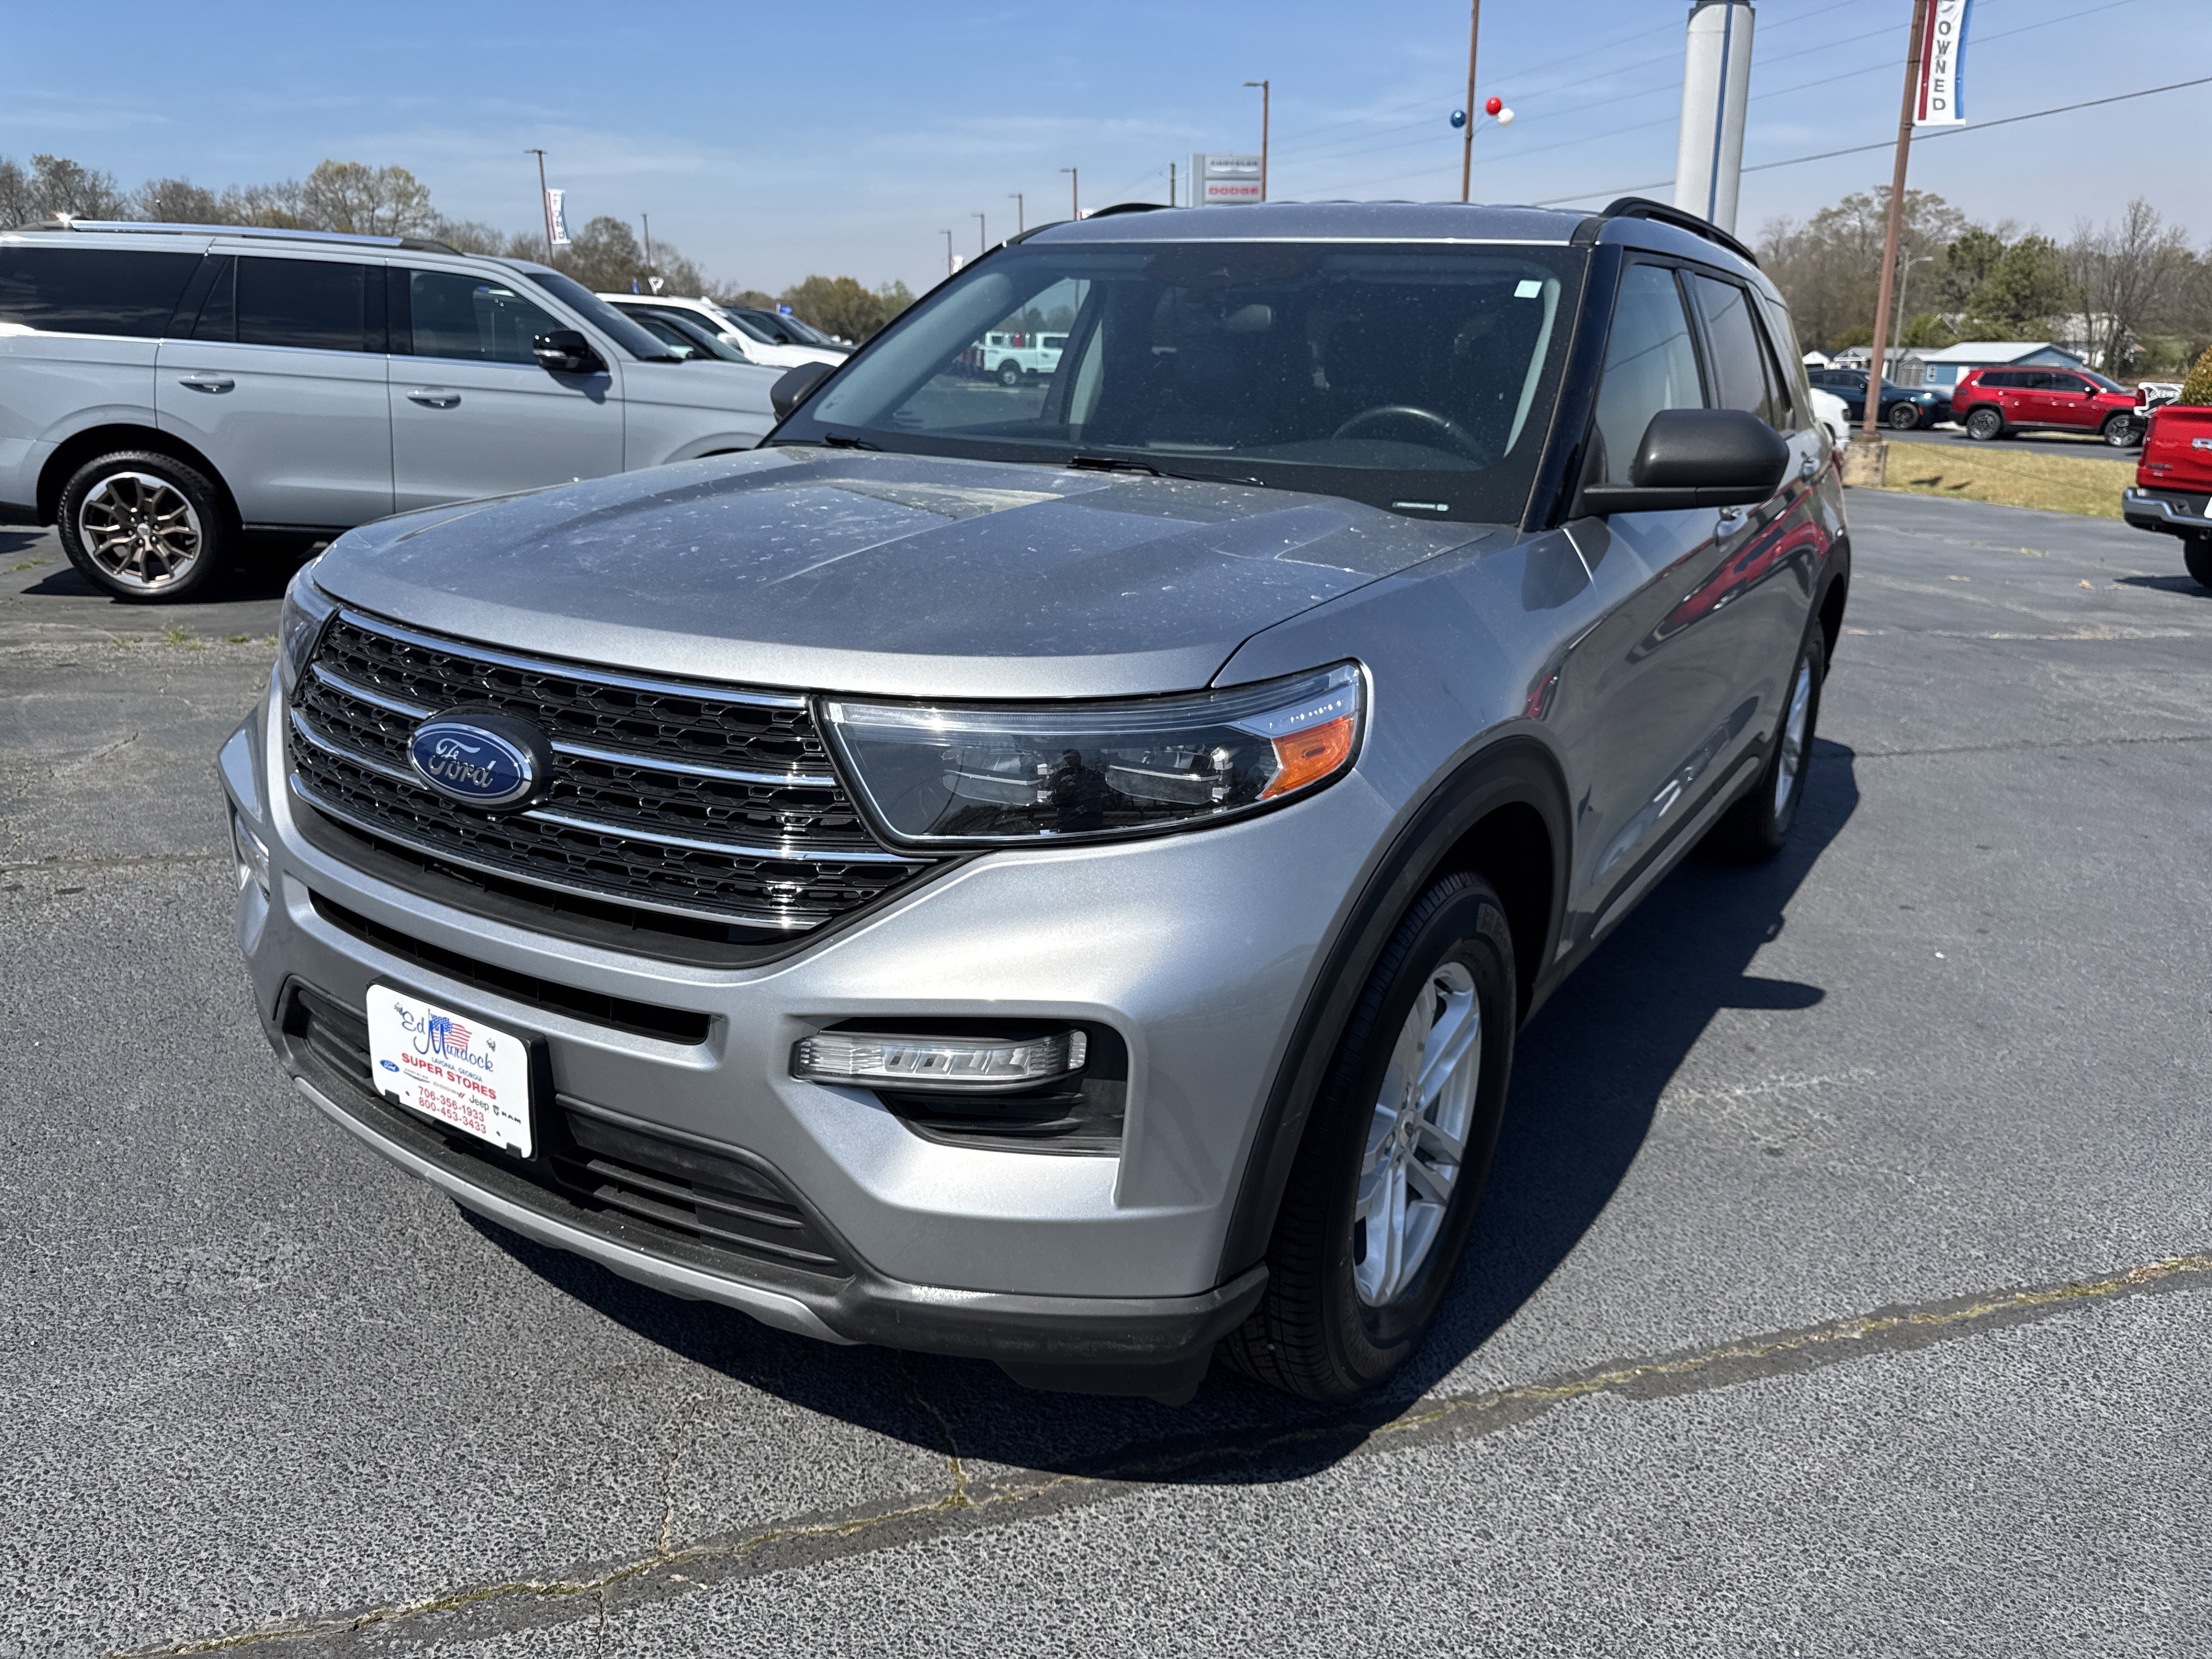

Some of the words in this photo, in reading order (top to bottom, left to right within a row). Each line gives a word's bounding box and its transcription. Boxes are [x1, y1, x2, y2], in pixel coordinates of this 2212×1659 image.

[1209, 186, 1259, 195] DODGE
[428, 738, 496, 788] Ford
[401, 1011, 426, 1034] Ed
[413, 1008, 494, 1073] Murdock
[402, 1052, 443, 1077] SUPER
[447, 1071, 497, 1100] STORES
[458, 1068, 483, 1082] GEORGIA
[418, 1086, 485, 1122] 706-356-1933
[419, 1097, 487, 1135] 800-453-3433
[469, 1094, 489, 1111] Jeep
[501, 1111, 522, 1124] RAM
